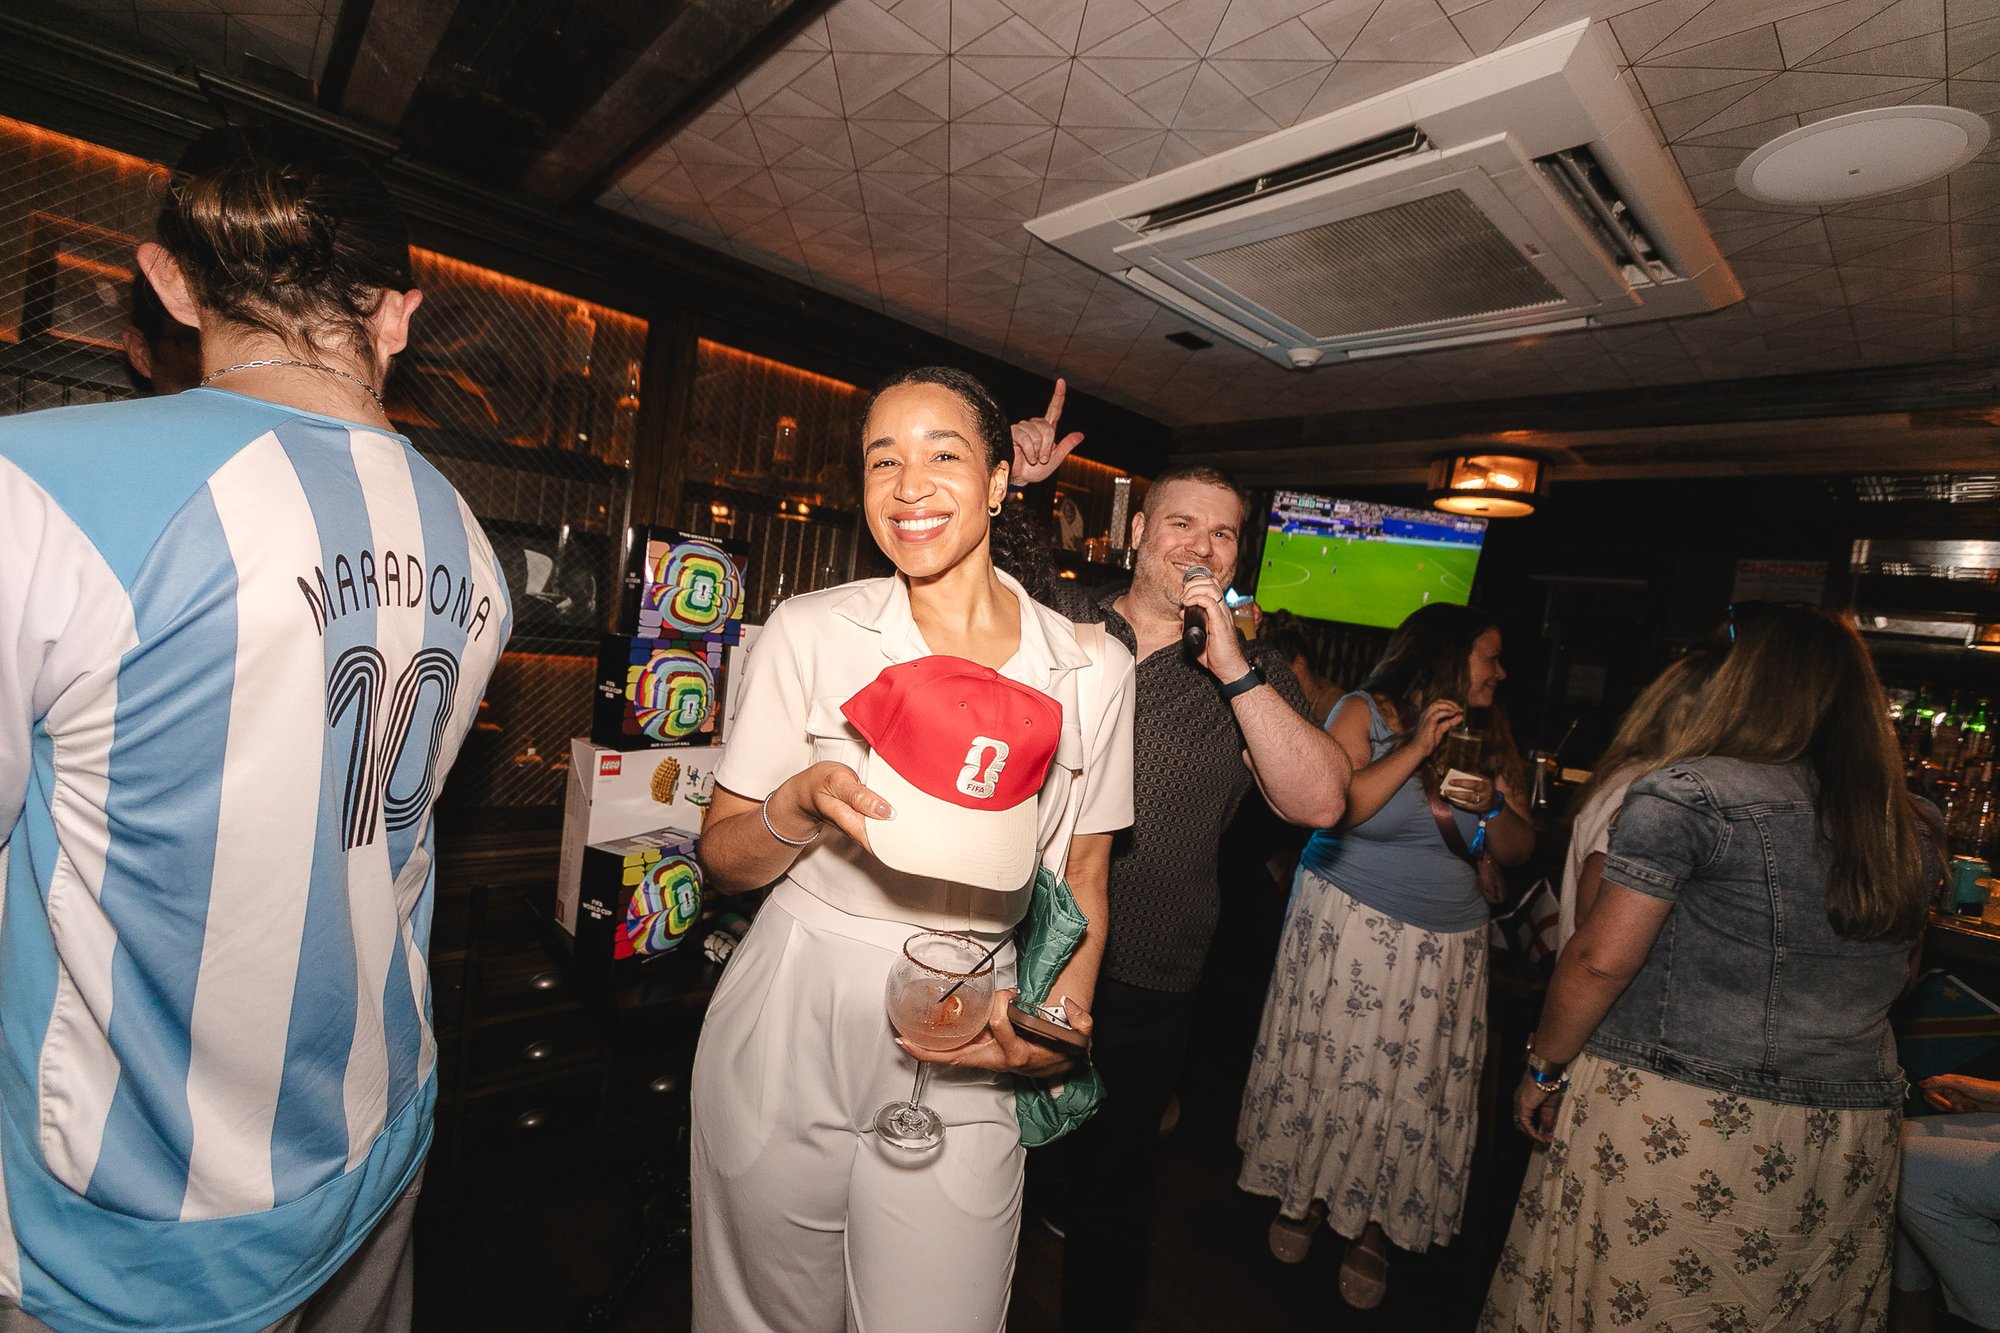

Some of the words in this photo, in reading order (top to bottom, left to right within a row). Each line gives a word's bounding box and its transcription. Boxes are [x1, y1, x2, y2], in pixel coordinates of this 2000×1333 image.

[297, 550, 490, 642] MARADONA
[327, 645, 459, 852] 10
[601, 760, 621, 770] LEGO
[966, 783, 985, 793] FIFA
